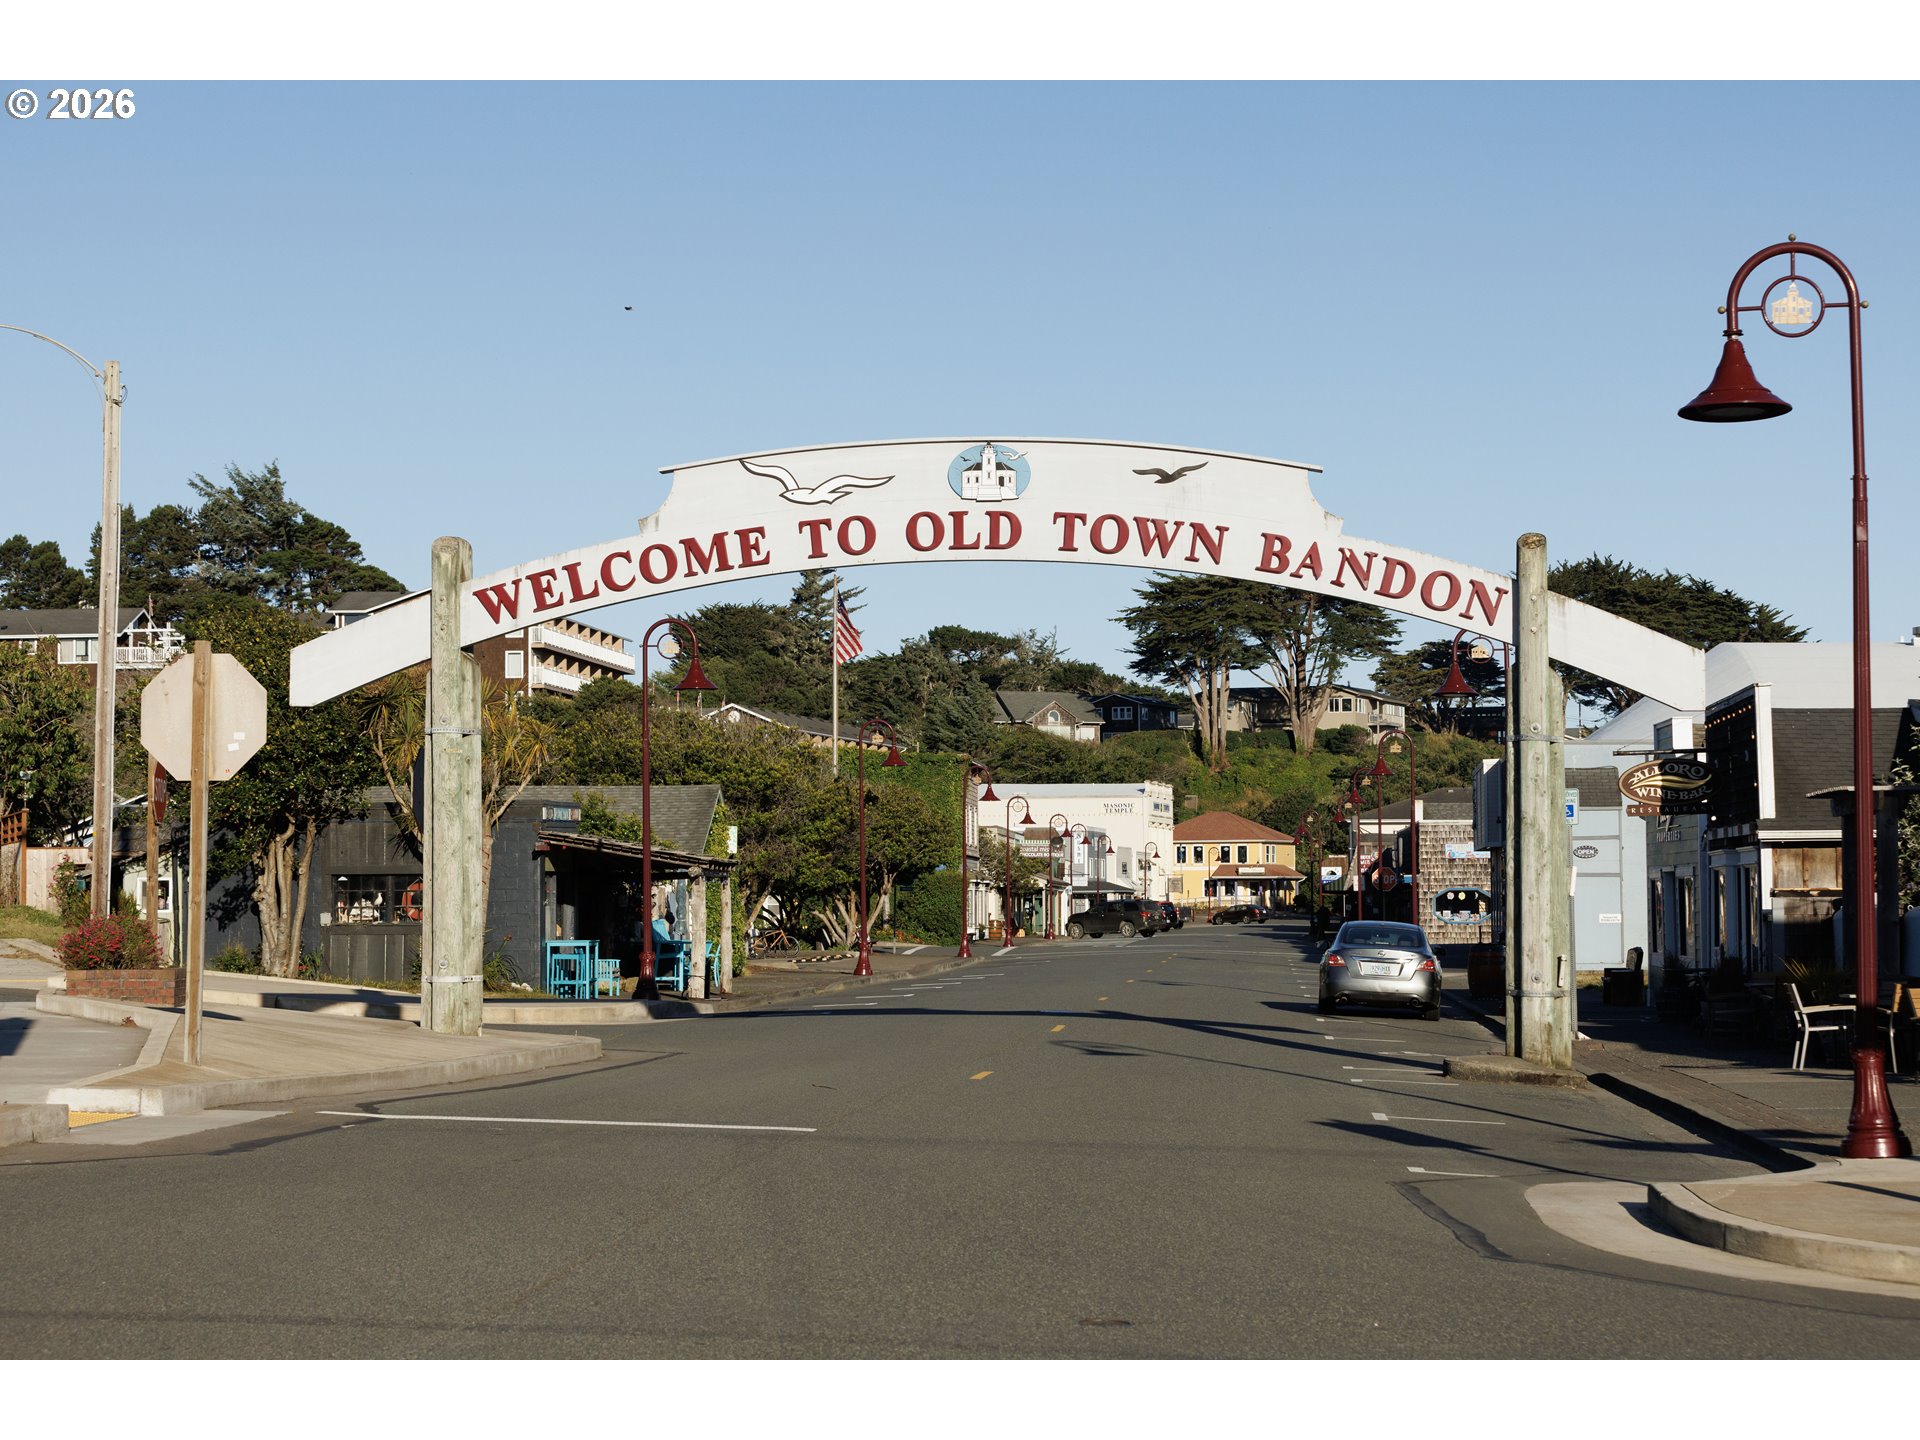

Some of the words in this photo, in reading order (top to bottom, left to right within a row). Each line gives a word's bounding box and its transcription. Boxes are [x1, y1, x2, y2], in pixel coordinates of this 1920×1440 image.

[474, 526, 771, 624] WELCOME
[799, 511, 877, 559] TO
[906, 511, 1023, 552] OLD
[1053, 511, 1228, 564] TOWN
[1259, 533, 1507, 625] BANDON
[1628, 763, 1705, 785] ALLORO
[1374, 874, 1395, 885] SOP
